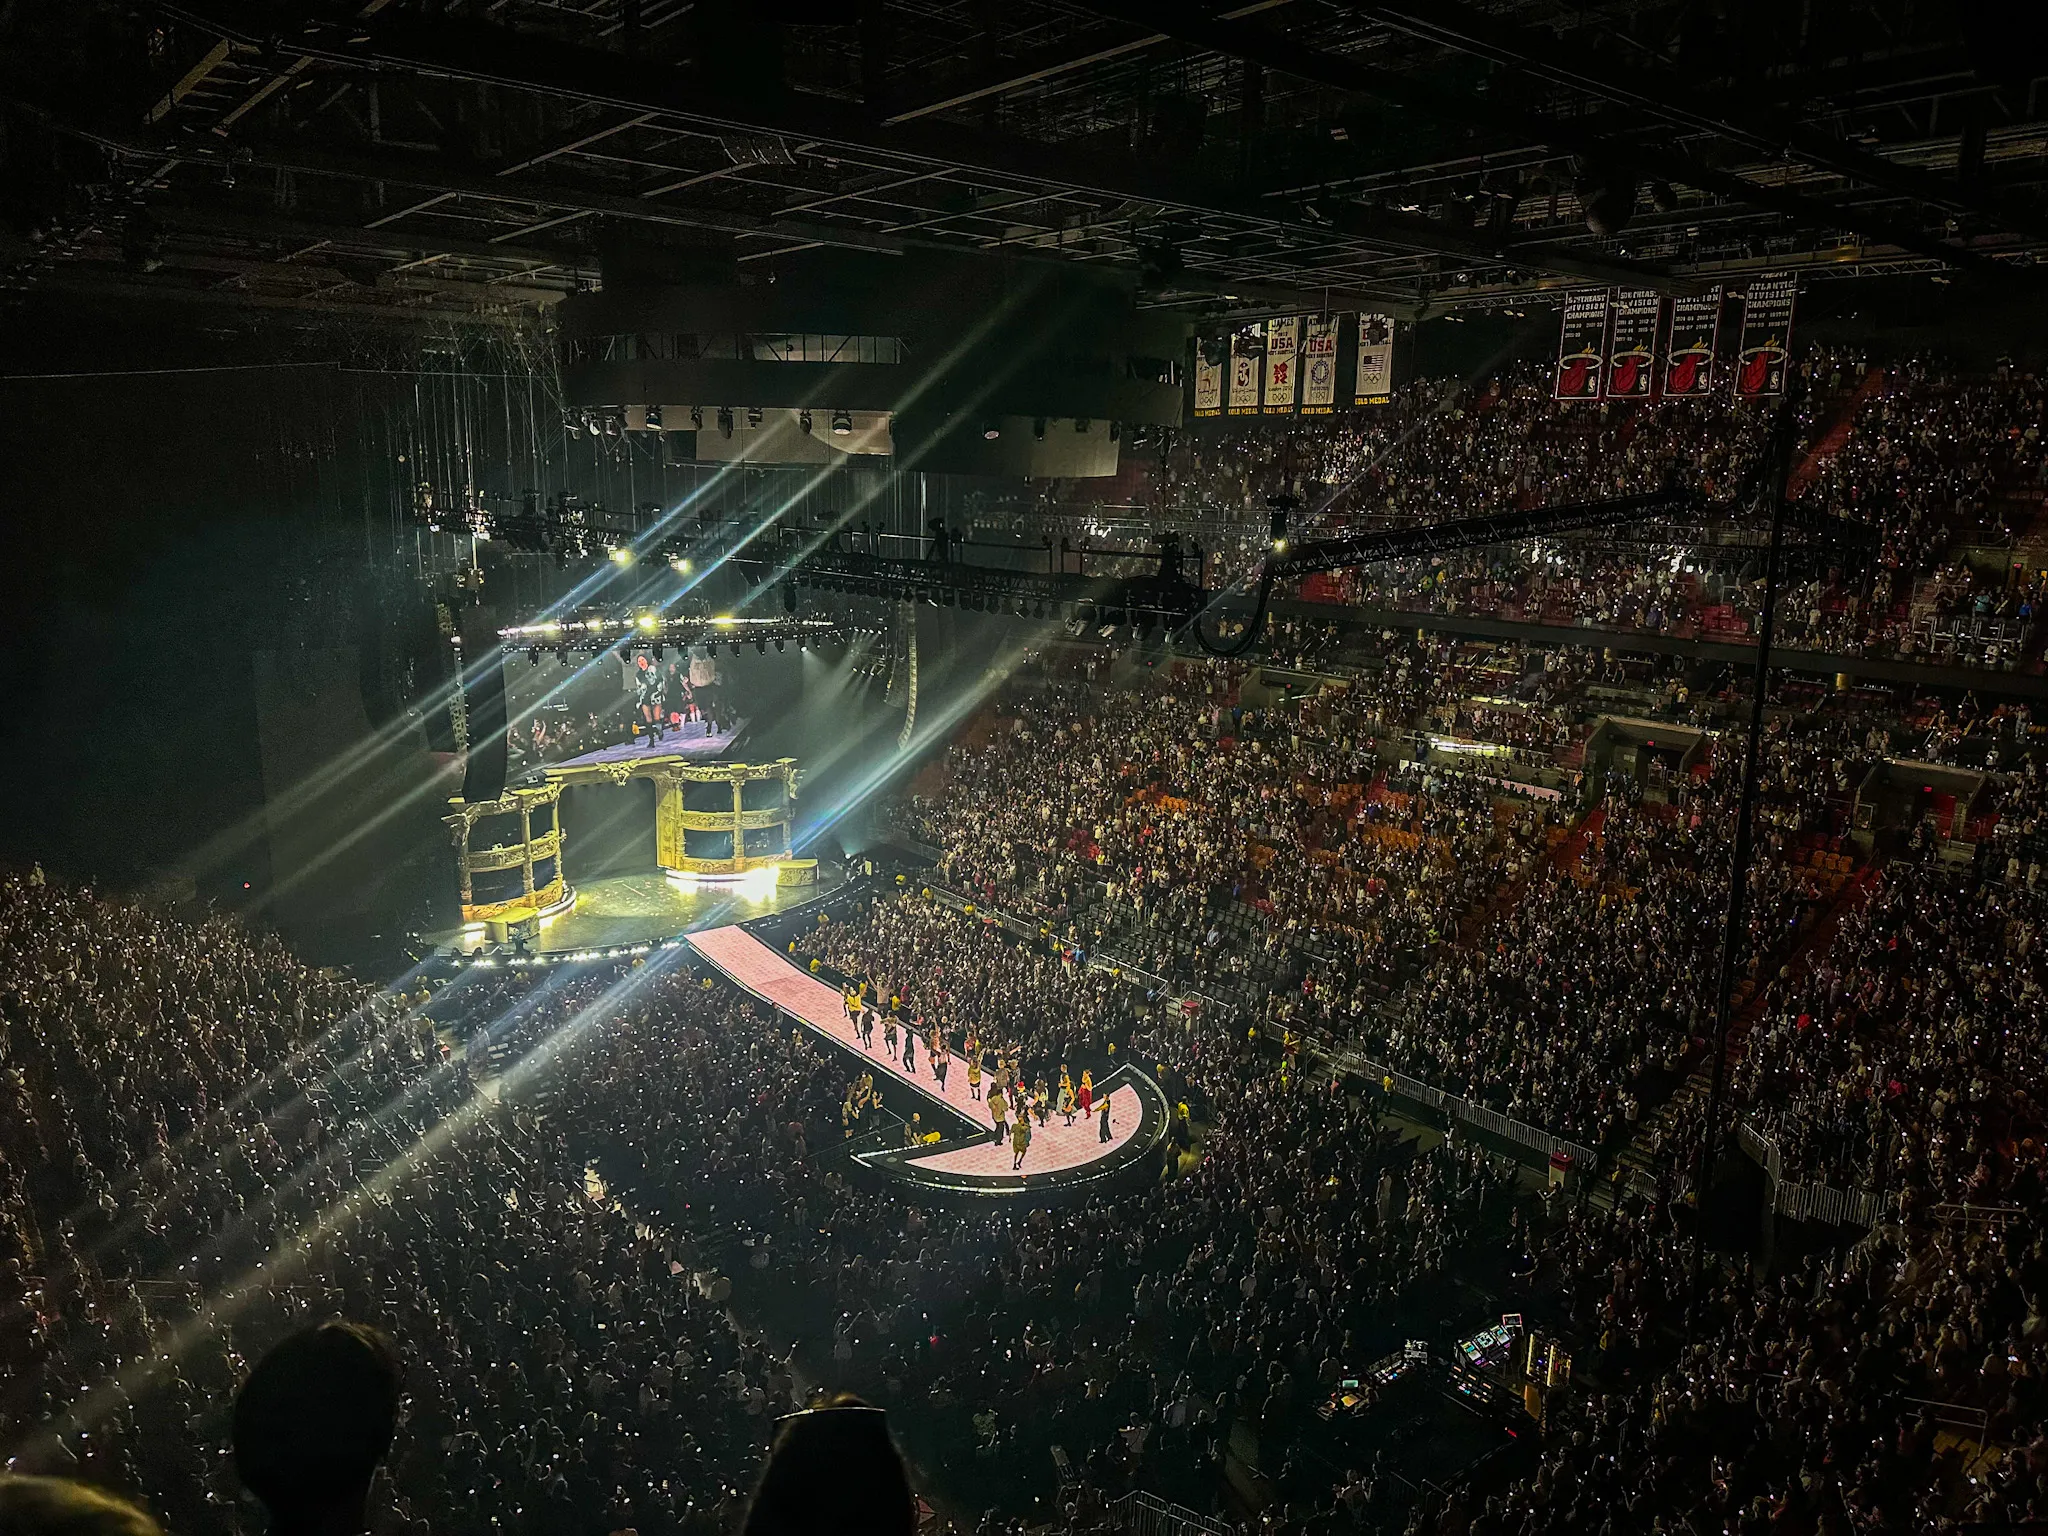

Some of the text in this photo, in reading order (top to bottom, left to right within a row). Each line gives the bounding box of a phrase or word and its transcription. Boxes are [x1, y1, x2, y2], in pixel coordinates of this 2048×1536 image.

[1749, 281, 1794, 290] ATLANTIC
[1748, 290, 1792, 299] DIVISION
[1619, 307, 1657, 315] CHAMPIONS
[1677, 303, 1716, 311] CHAMPI
[1567, 310, 1604, 319] CHAMPIONS
[1271, 317, 1294, 327] JAMES
[1271, 338, 1293, 349] USA
[1309, 339, 1332, 352] USA
[1355, 396, 1390, 405] GOLD MEDAL
[1241, 407, 1258, 415] MEDAL
